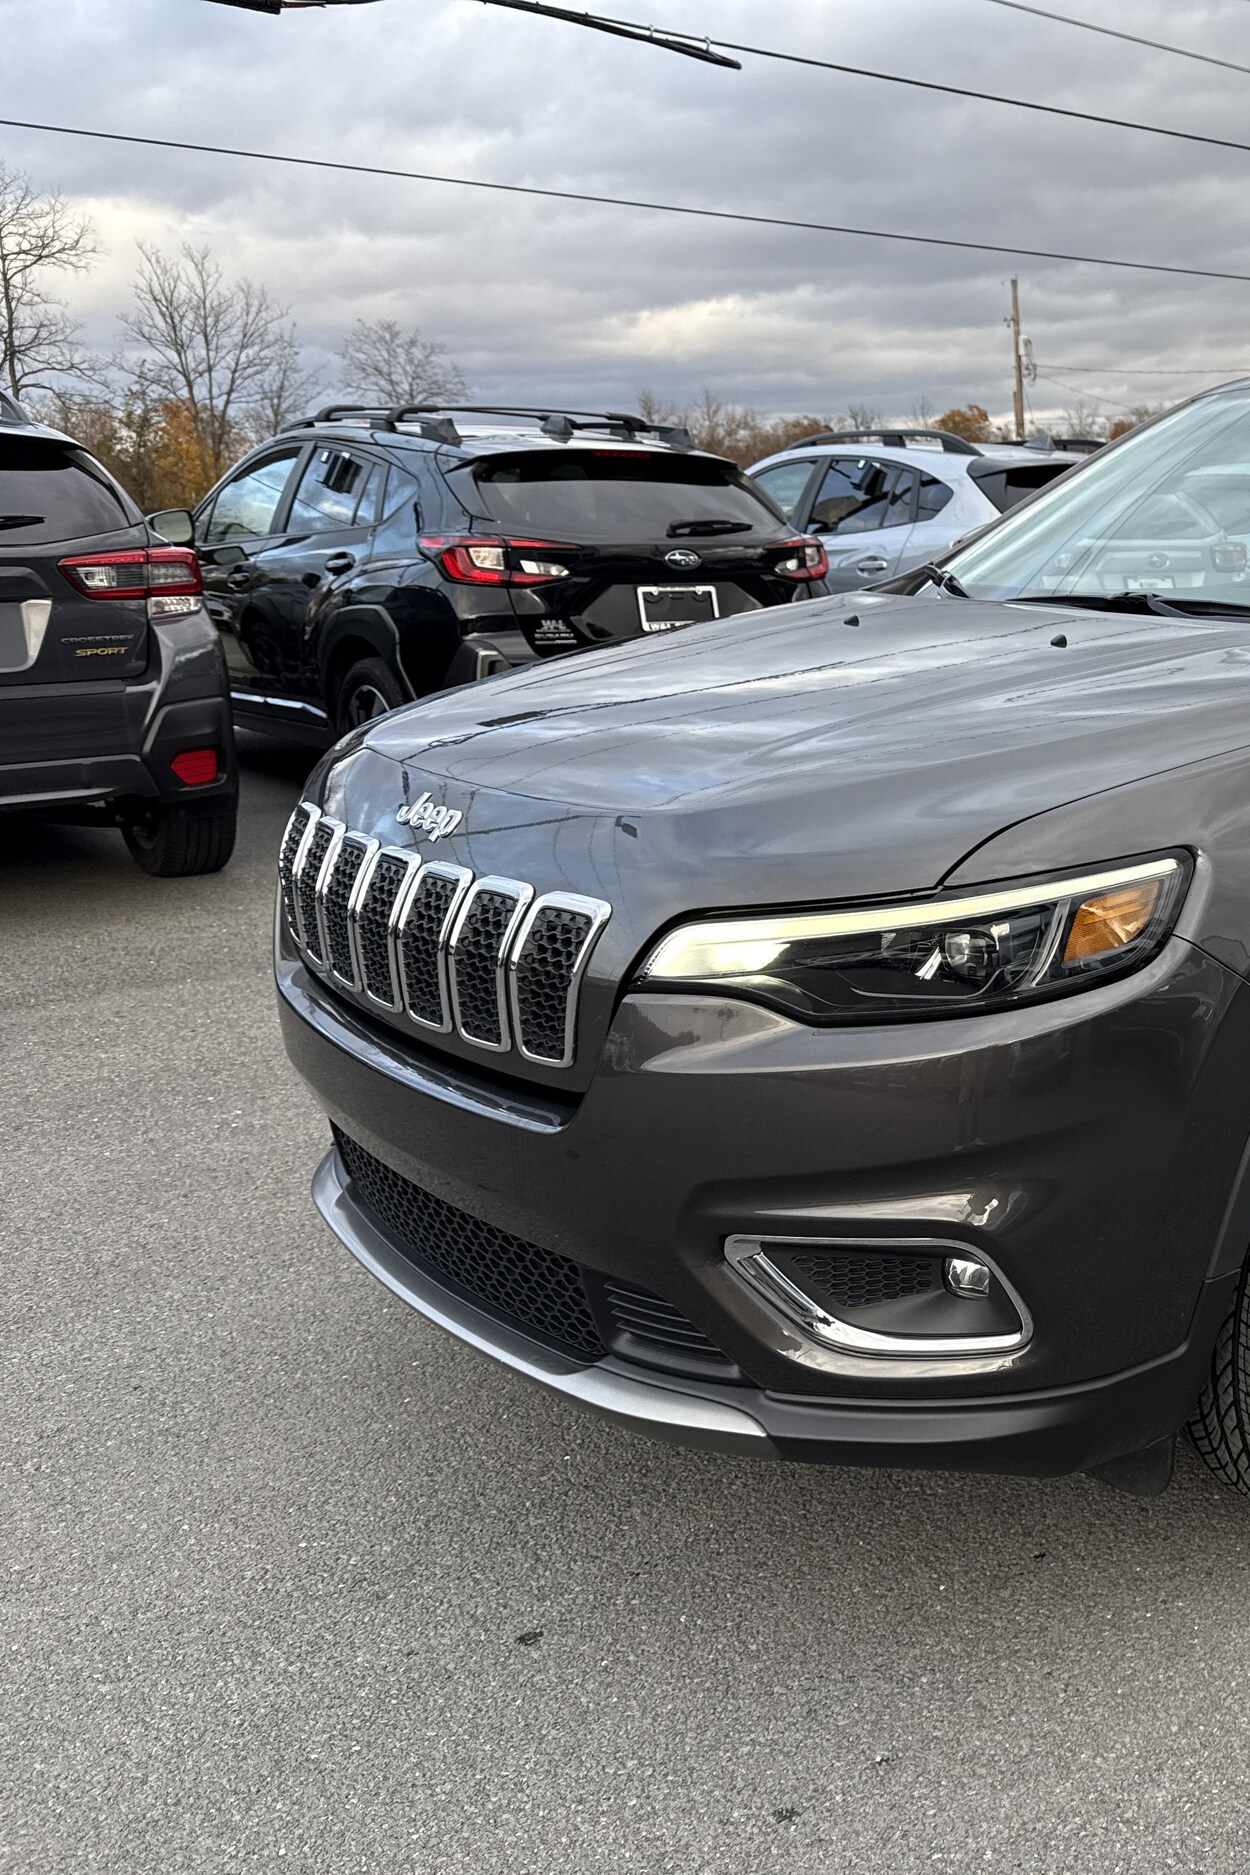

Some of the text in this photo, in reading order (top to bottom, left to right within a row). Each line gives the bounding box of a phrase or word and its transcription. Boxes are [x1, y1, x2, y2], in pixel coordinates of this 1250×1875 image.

[60, 634, 135, 645] CROSSTREK
[74, 646, 129, 657] SPORT
[395, 791, 462, 844] Jeep
